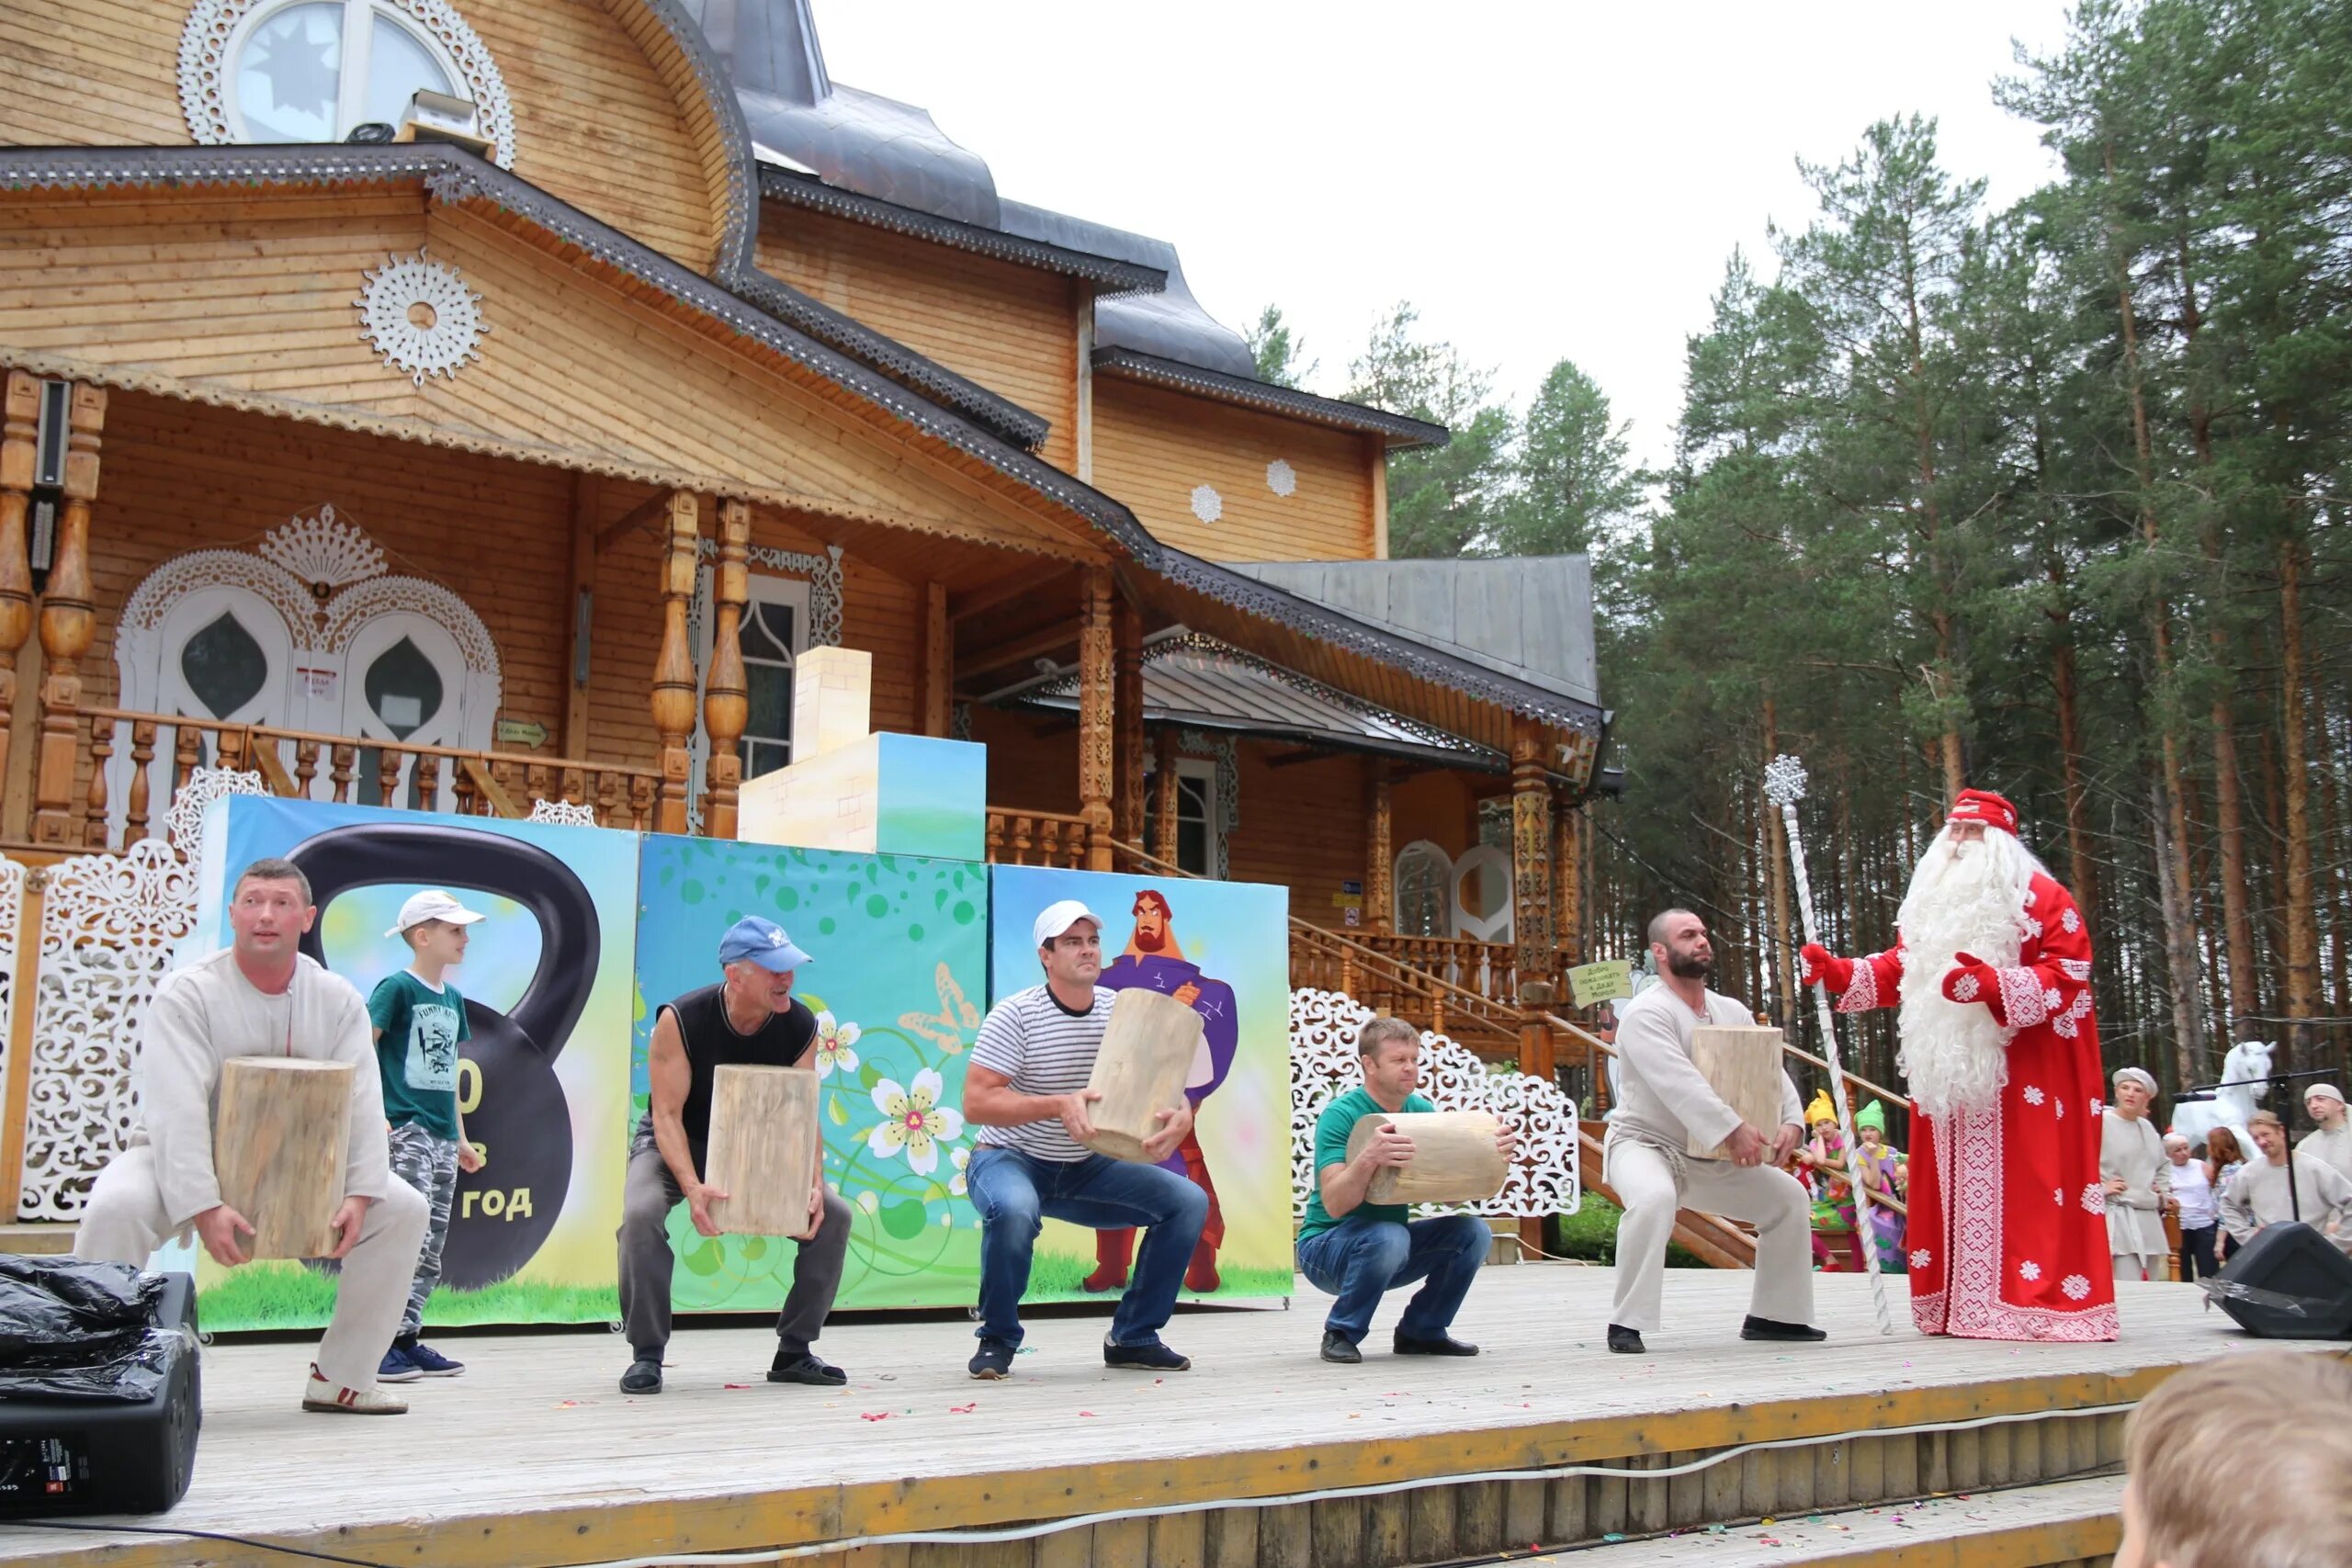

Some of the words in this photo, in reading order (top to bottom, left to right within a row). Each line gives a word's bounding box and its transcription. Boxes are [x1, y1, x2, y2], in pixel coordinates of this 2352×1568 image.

[1588, 966, 1609, 976] Добро
[1579, 972, 1621, 985] пожаловать
[1596, 982, 1614, 990] Деду
[1591, 989, 1616, 998] Морозу
[418, 1005, 441, 1020] FUNNY
[461, 1187, 533, 1223] год
